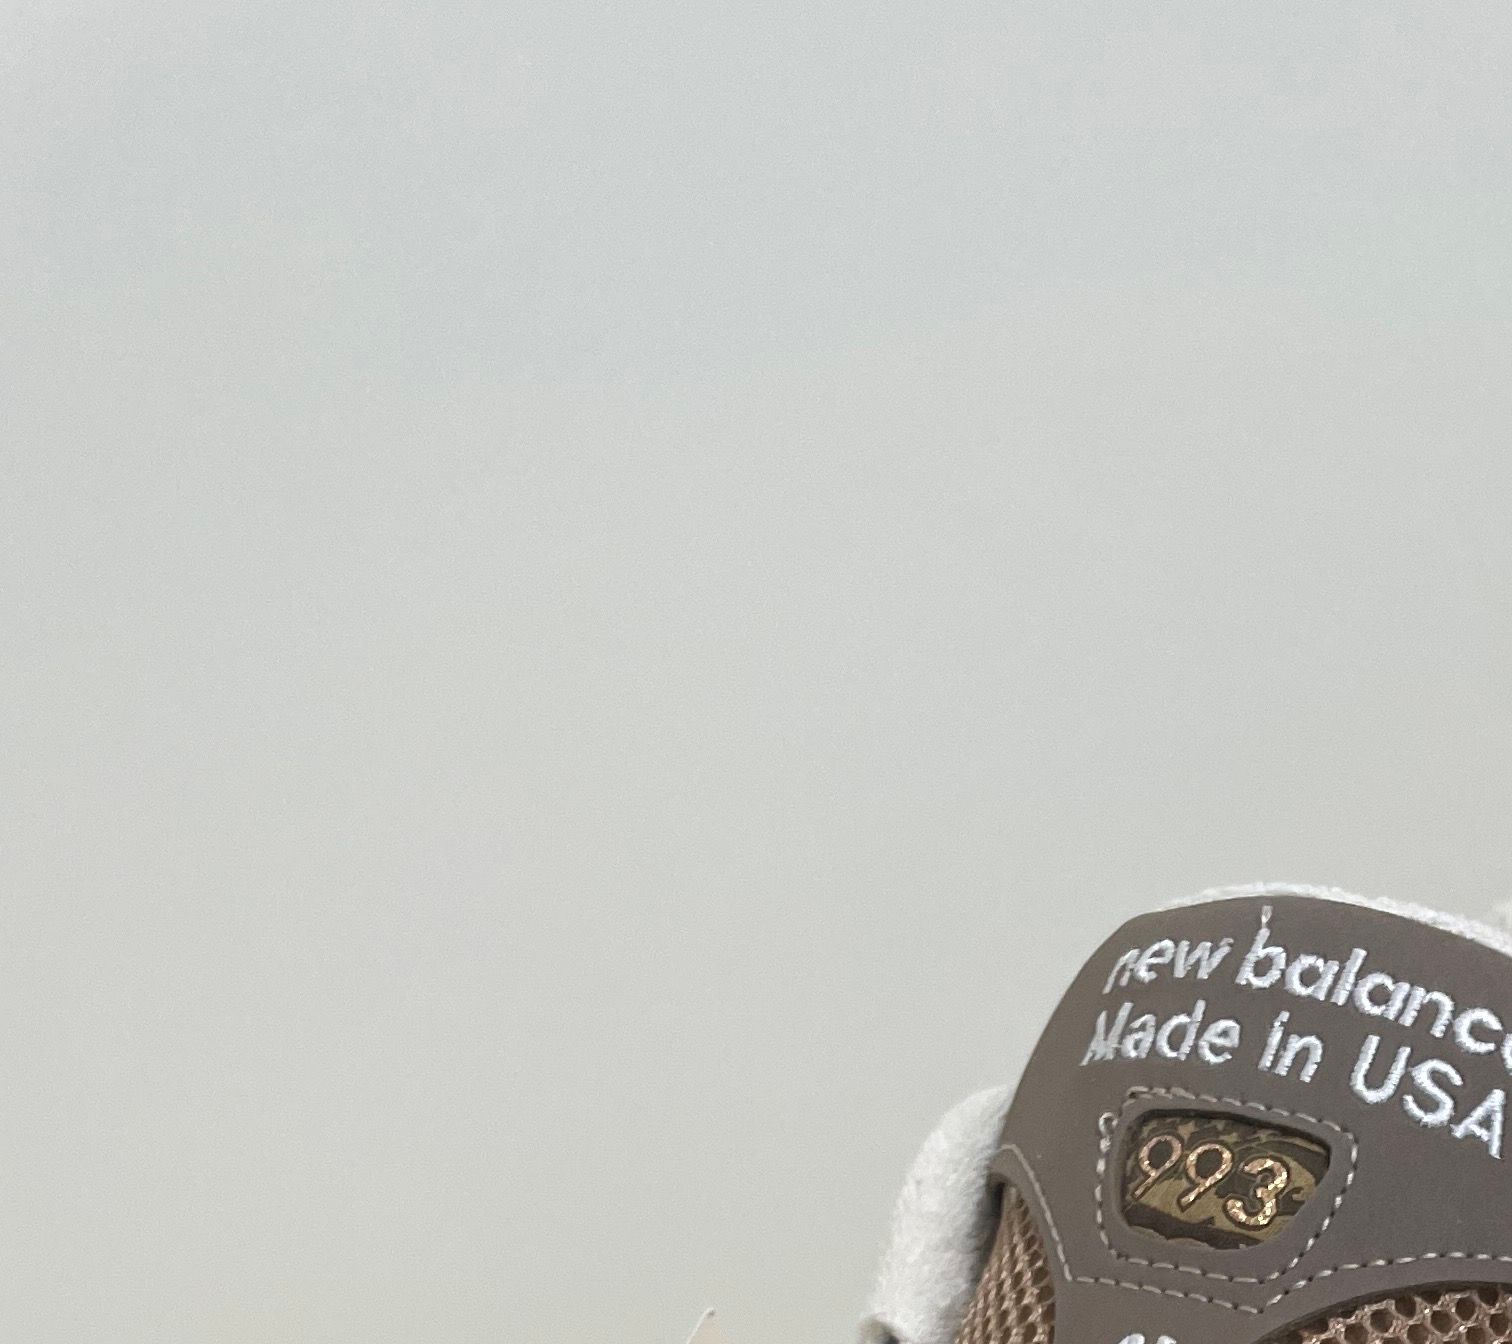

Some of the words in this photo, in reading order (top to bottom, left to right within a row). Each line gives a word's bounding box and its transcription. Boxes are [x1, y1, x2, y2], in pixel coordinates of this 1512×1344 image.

[1102, 936, 1233, 995] new
[1080, 1000, 1241, 1066] Made
[1258, 1010, 1323, 1082] in
[1350, 1035, 1506, 1159] USA
[1132, 1134, 1293, 1230] 993
